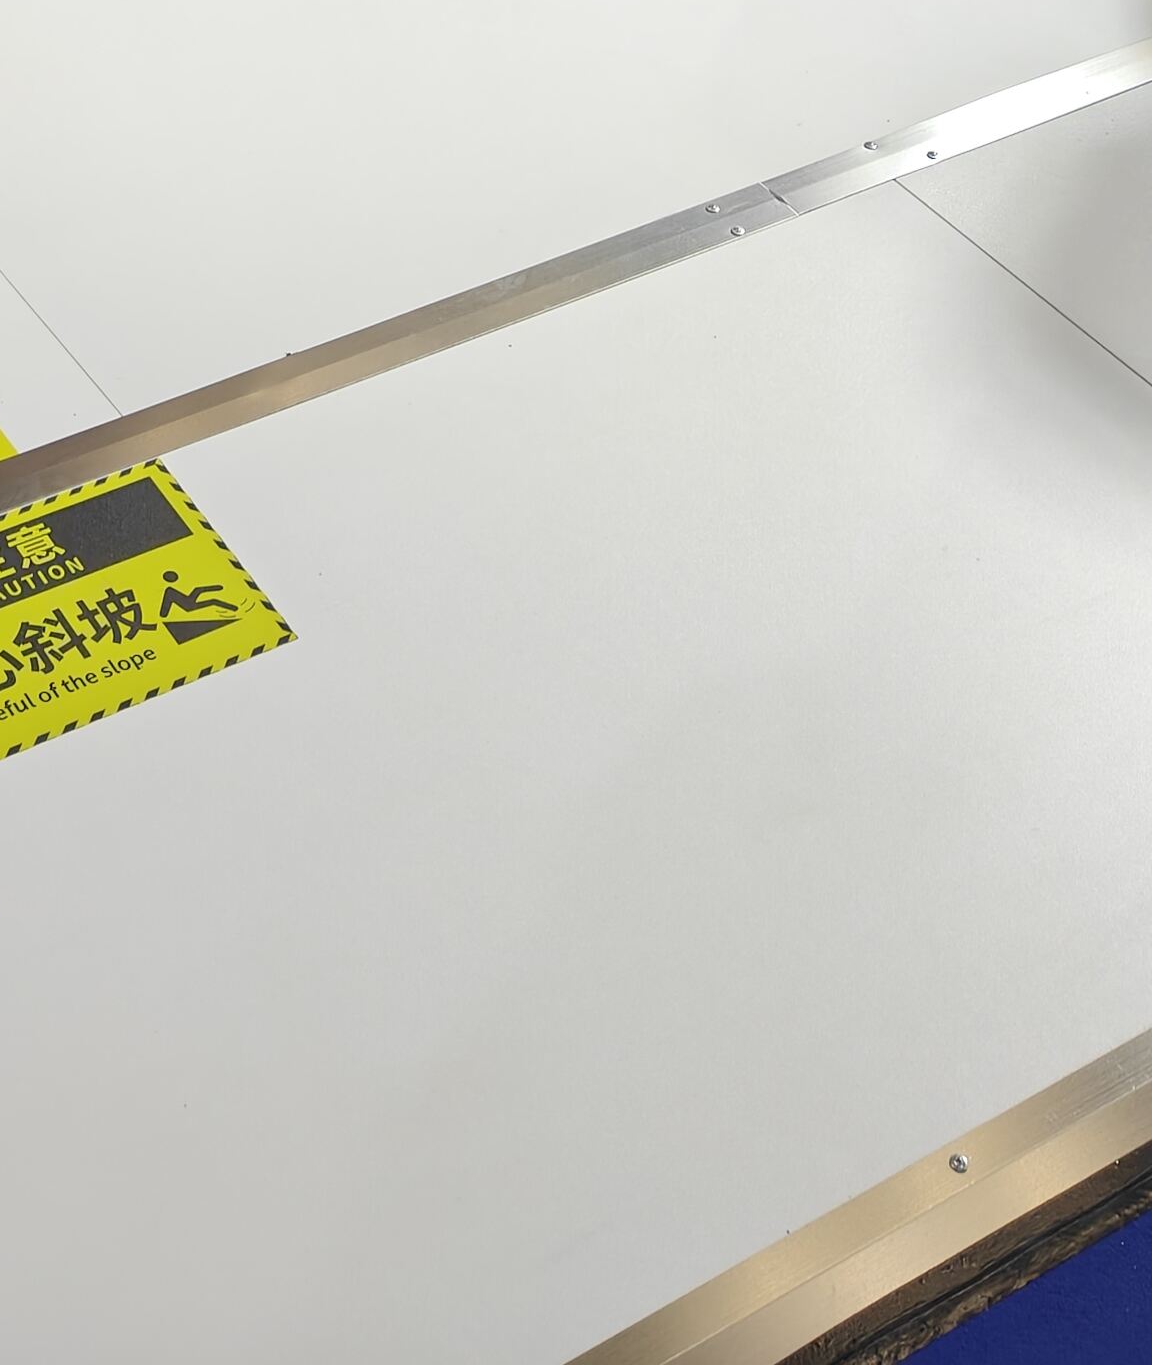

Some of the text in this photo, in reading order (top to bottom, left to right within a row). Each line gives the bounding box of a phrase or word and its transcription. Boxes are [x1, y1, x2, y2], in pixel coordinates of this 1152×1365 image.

[38, 681, 63, 703] of
[61, 667, 98, 694] the
[100, 646, 157, 678] slope
